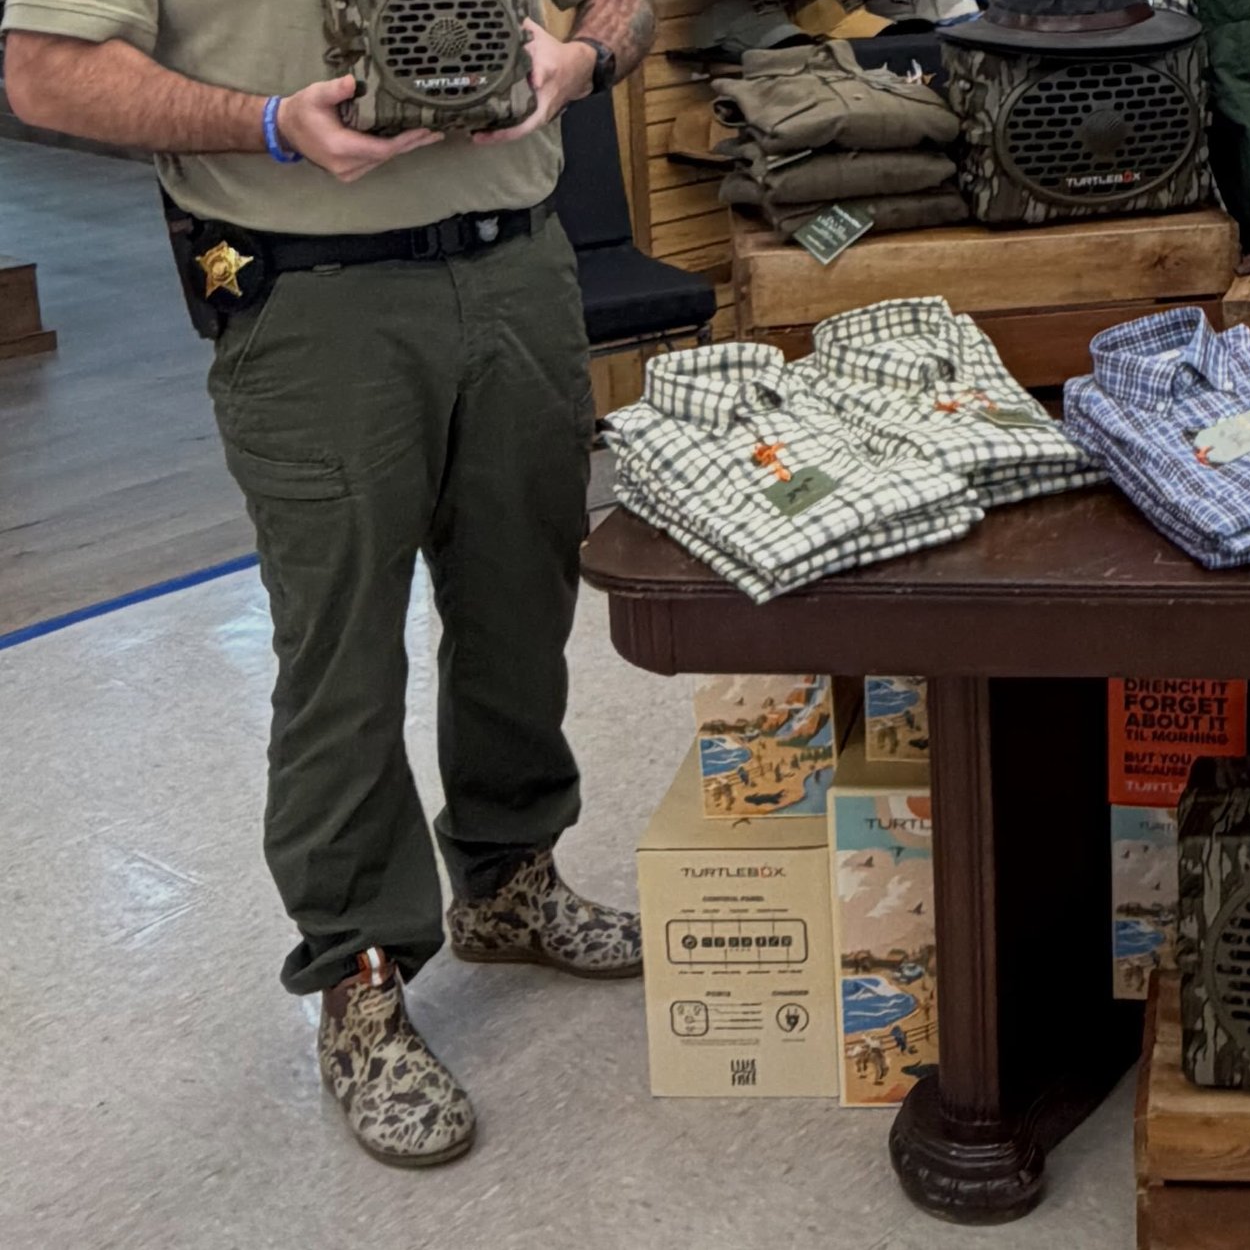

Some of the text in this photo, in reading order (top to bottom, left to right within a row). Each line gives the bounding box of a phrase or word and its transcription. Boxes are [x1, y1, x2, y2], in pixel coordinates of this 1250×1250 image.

[414, 75, 488, 88] TURTLEBOX
[1065, 170, 1141, 187] TURTLEBOX
[1124, 679, 1228, 695] DRENCH IT
[1124, 694, 1228, 715] FORGET
[1125, 713, 1228, 731] ABOUT IT
[1125, 729, 1149, 741] TIL
[1124, 752, 1191, 765] BUT YOU
[865, 818, 933, 830] TURTL
[680, 864, 787, 879] TURTLEBOX
